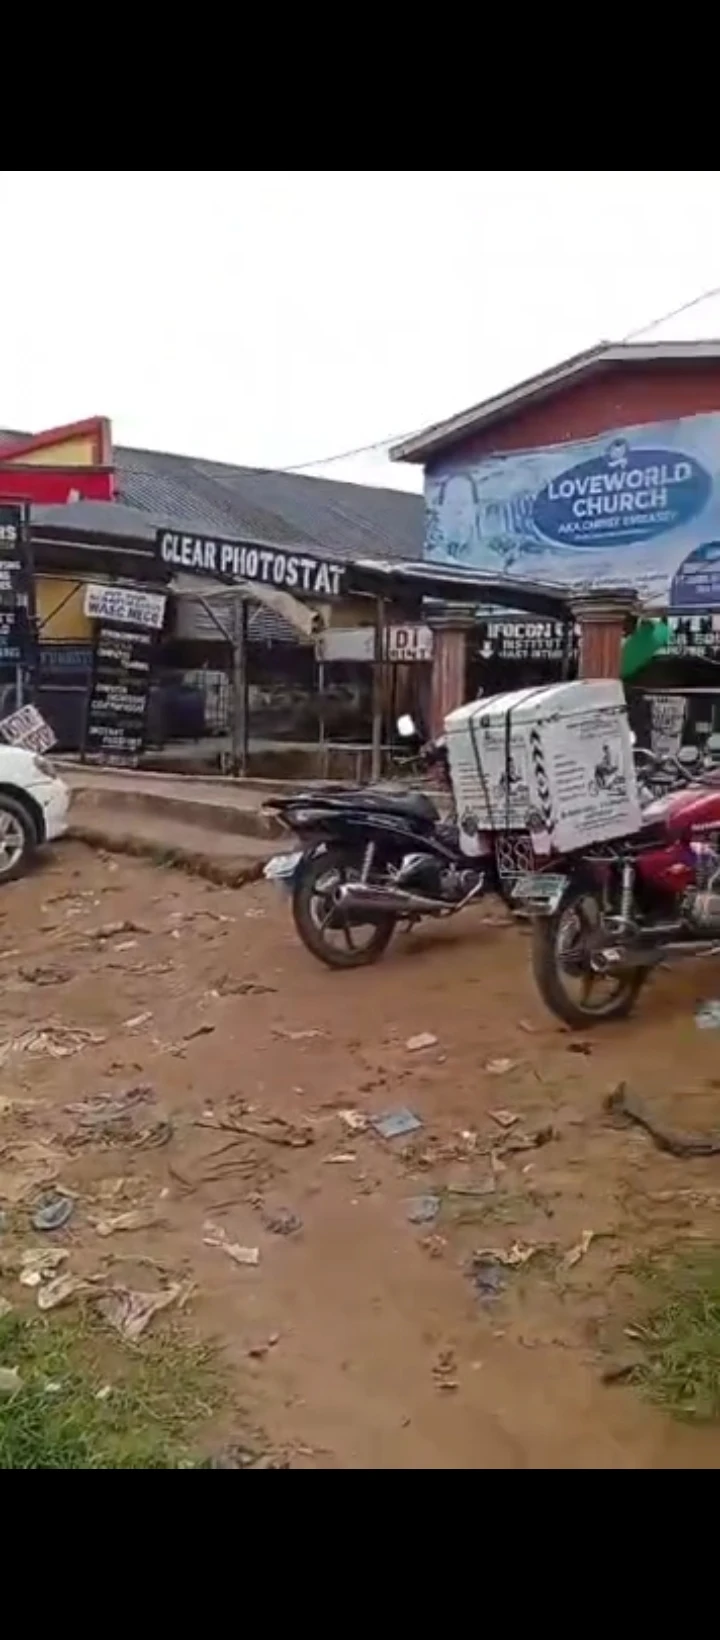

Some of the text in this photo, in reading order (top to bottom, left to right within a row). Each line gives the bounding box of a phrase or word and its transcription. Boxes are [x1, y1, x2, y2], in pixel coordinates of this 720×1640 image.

[548, 462, 692, 499] LOVEWORLD
[573, 488, 668, 517] CHURCH
[161, 532, 346, 594] CLEAR PHOTOSTAT
